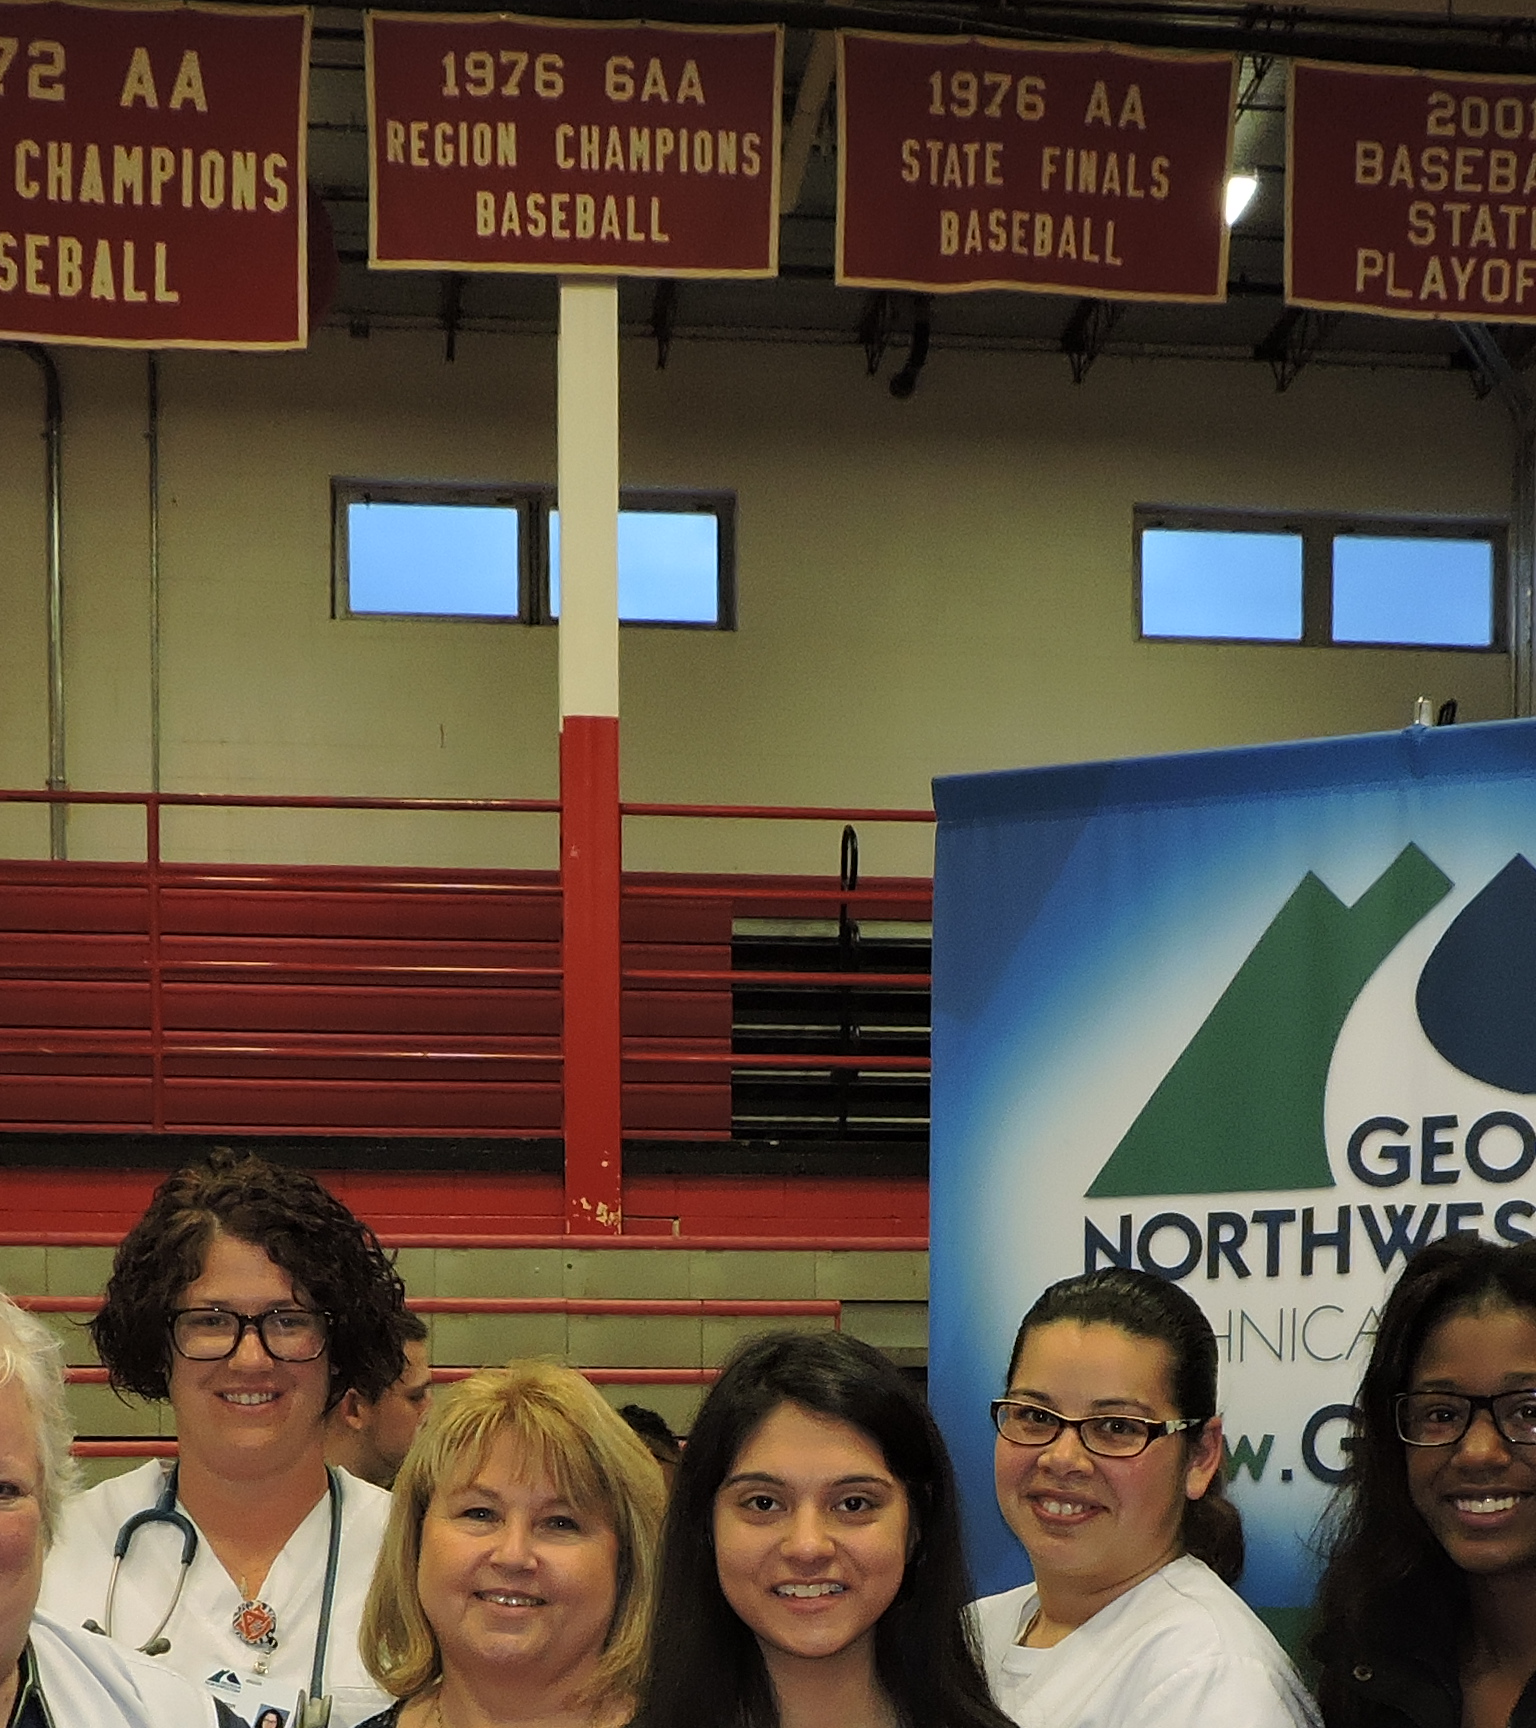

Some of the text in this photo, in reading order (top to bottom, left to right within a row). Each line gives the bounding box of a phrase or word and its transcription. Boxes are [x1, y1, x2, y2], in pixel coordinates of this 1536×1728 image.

[120, 46, 208, 113] AA
[440, 50, 708, 107] 1976 6AA
[927, 69, 1148, 131] 1976 AA
[14, 138, 289, 214] CHAMPIONS
[386, 117, 763, 178] REGION CHAMPIONS
[900, 138, 1171, 201] STATE FINALS
[475, 192, 671, 245] BASEBALL
[938, 208, 1124, 268] BASEBALL
